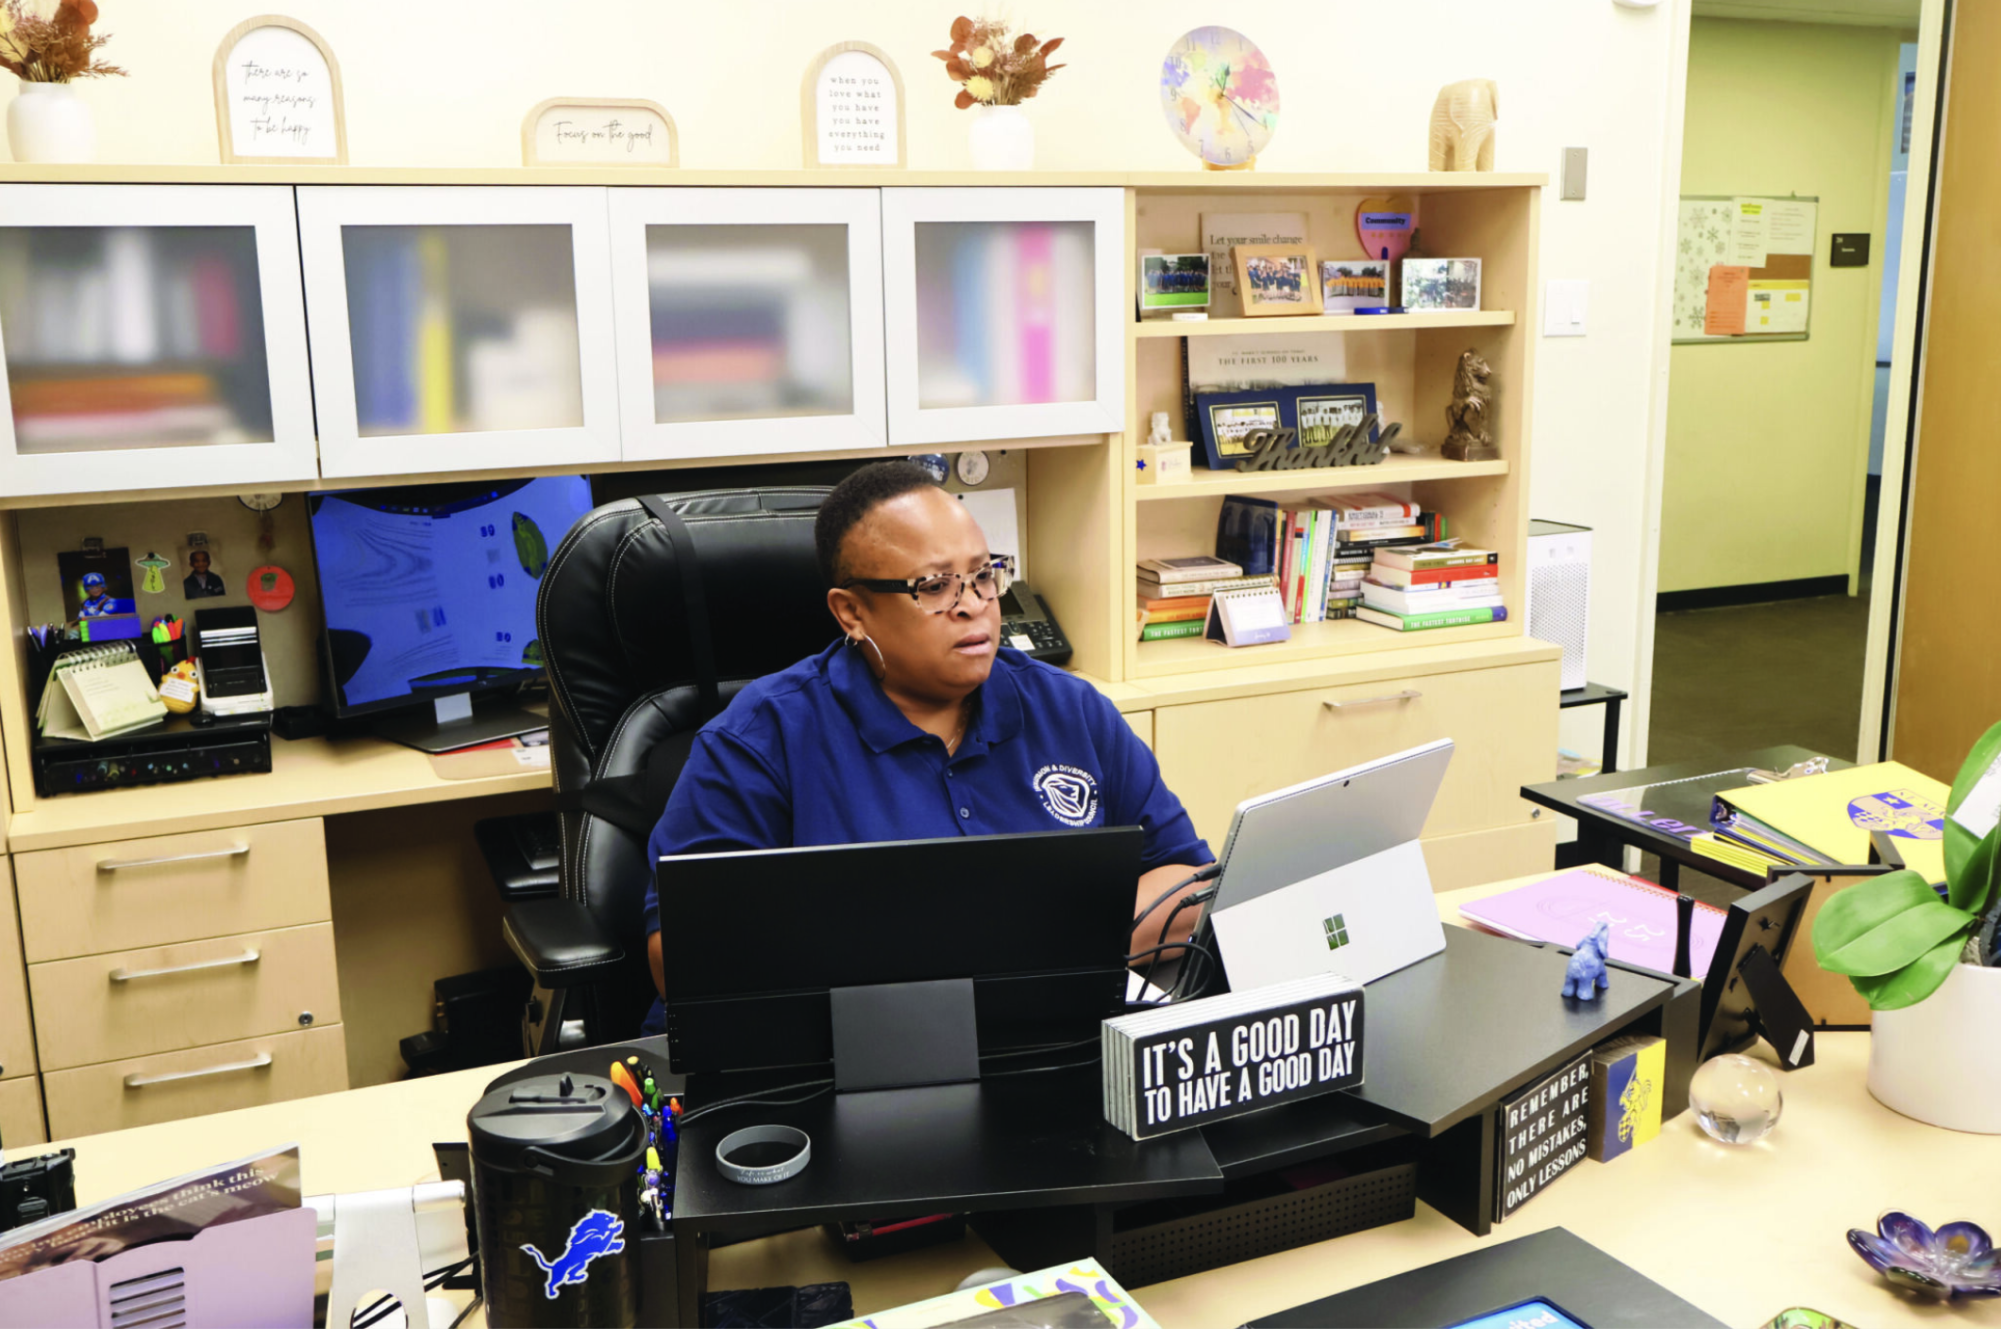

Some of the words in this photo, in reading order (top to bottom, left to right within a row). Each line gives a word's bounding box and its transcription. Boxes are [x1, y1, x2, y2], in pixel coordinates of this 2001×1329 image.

[274, 69, 292, 80] are
[830, 76, 857, 85] when
[862, 78, 880, 86] you
[243, 95, 271, 116] many
[273, 94, 315, 109] reasons
[829, 89, 851, 98] love
[856, 90, 881, 99] what
[832, 104, 850, 113] you
[855, 103, 879, 112] have
[266, 115, 278, 134] be
[281, 115, 311, 146] happy
[832, 117, 851, 126] you
[855, 116, 879, 125] have
[553, 121, 588, 144] Focus
[592, 131, 605, 139] on
[627, 123, 654, 153] good
[828, 130, 885, 141] everything
[834, 144, 852, 154] you
[857, 143, 880, 152] need
[1365, 216, 1406, 226] Community
[1210, 234, 1226, 246] Let
[1226, 235, 1248, 247] your
[1249, 233, 1272, 245] smile
[1272, 234, 1304, 246] change
[1218, 357, 1237, 367] THE
[1241, 356, 1268, 366] FIRST
[1272, 355, 1288, 365] 100
[1290, 354, 1320, 364] YEARS
[1235, 413, 1402, 473] Thankful
[1150, 627, 1162, 638] THE
[1163, 625, 1187, 636] FASTEST
[1410, 621, 1421, 629] THE
[1422, 618, 1445, 628] FASTEST
[1446, 615, 1471, 626] TORTOISE
[1059, 764, 1098, 786] DIVERSITY
[1043, 801, 1085, 828] LEADERSHIP
[1143, 1037, 1195, 1090] IT'S
[1204, 1031, 1223, 1075] A
[1231, 1014, 1301, 1068] GOOD
[1309, 1000, 1357, 1050] DAY
[1144, 1086, 1172, 1125] TO
[1178, 1071, 1232, 1118] HAVE
[1238, 1066, 1253, 1103] A
[1258, 1052, 1313, 1097] GOOD
[1318, 1041, 1356, 1083] DAY
[1509, 1063, 1589, 1129] REMEMBER,
[1509, 1109, 1556, 1156] THERE
[1562, 1086, 1589, 1119] ARE
[1507, 1157, 1525, 1184] NO
[1527, 1115, 1588, 1169] MISTAKES,
[172, 1178, 226, 1201] think
[229, 1168, 265, 1184] this
[737, 1175, 752, 1183] YOU
[753, 1175, 773, 1183] MAKE
[773, 1173, 783, 1182] OF
[1506, 1174, 1537, 1210] ONLY
[1538, 1137, 1587, 1187] LESSONS
[123, 1213, 140, 1223] is
[144, 1203, 175, 1218] the
[178, 1189, 220, 1207] cat's
[224, 1171, 279, 1195] meow
